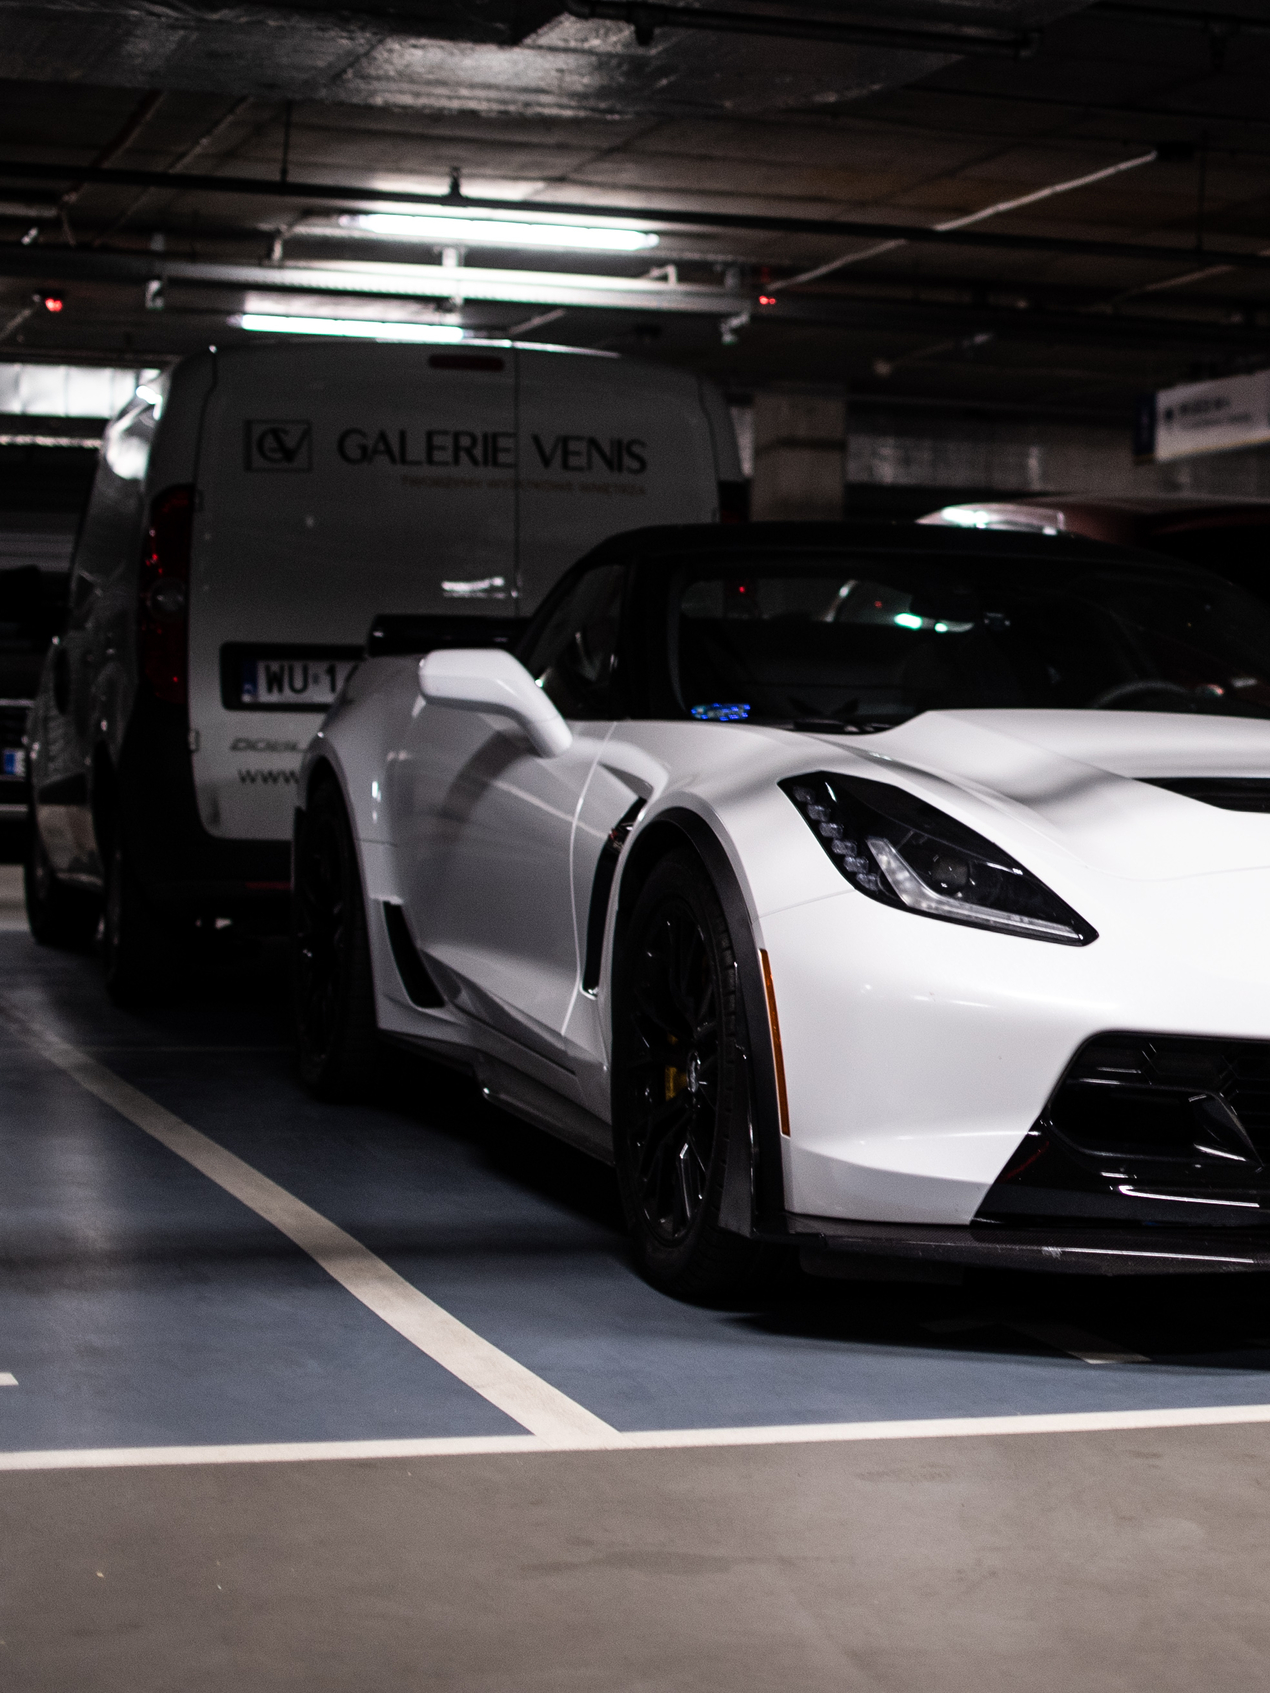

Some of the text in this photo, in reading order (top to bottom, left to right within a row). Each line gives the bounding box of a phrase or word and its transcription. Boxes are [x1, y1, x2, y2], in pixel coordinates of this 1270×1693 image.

[336, 427, 648, 475] GALERIE VENIS
[264, 663, 309, 694] WU
